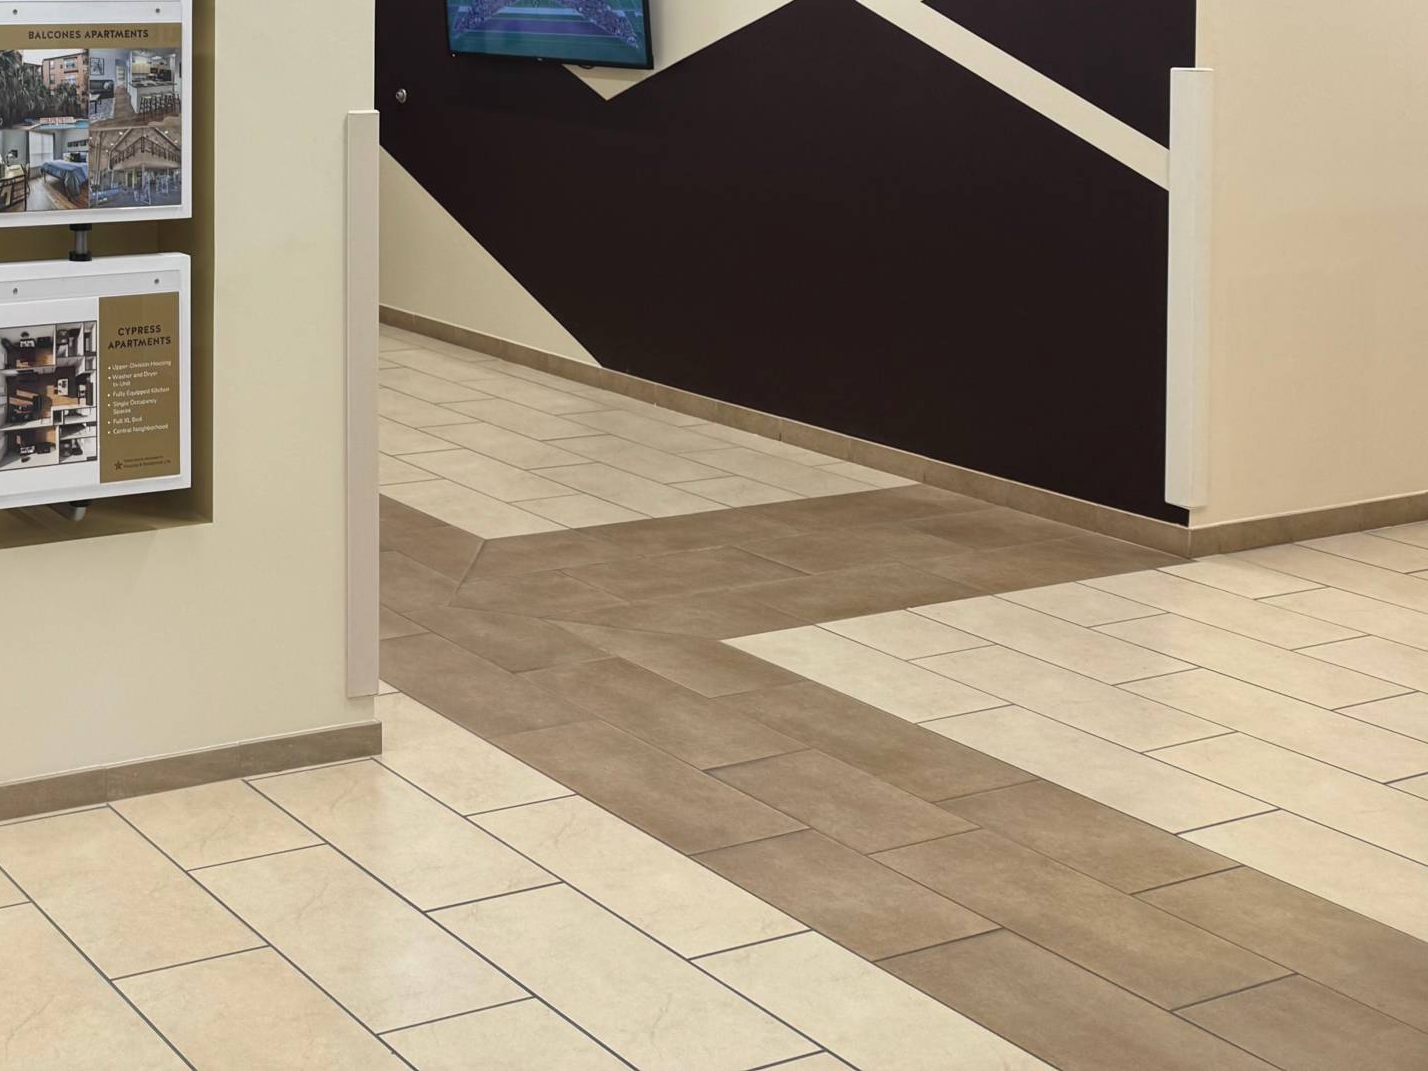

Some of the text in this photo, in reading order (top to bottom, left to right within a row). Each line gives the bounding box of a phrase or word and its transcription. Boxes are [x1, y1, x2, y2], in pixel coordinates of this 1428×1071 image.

[29, 29, 149, 39] BALCONES APARTMENTS
[118, 325, 162, 336] CYPRESS
[108, 336, 171, 349] APARTMENTS
